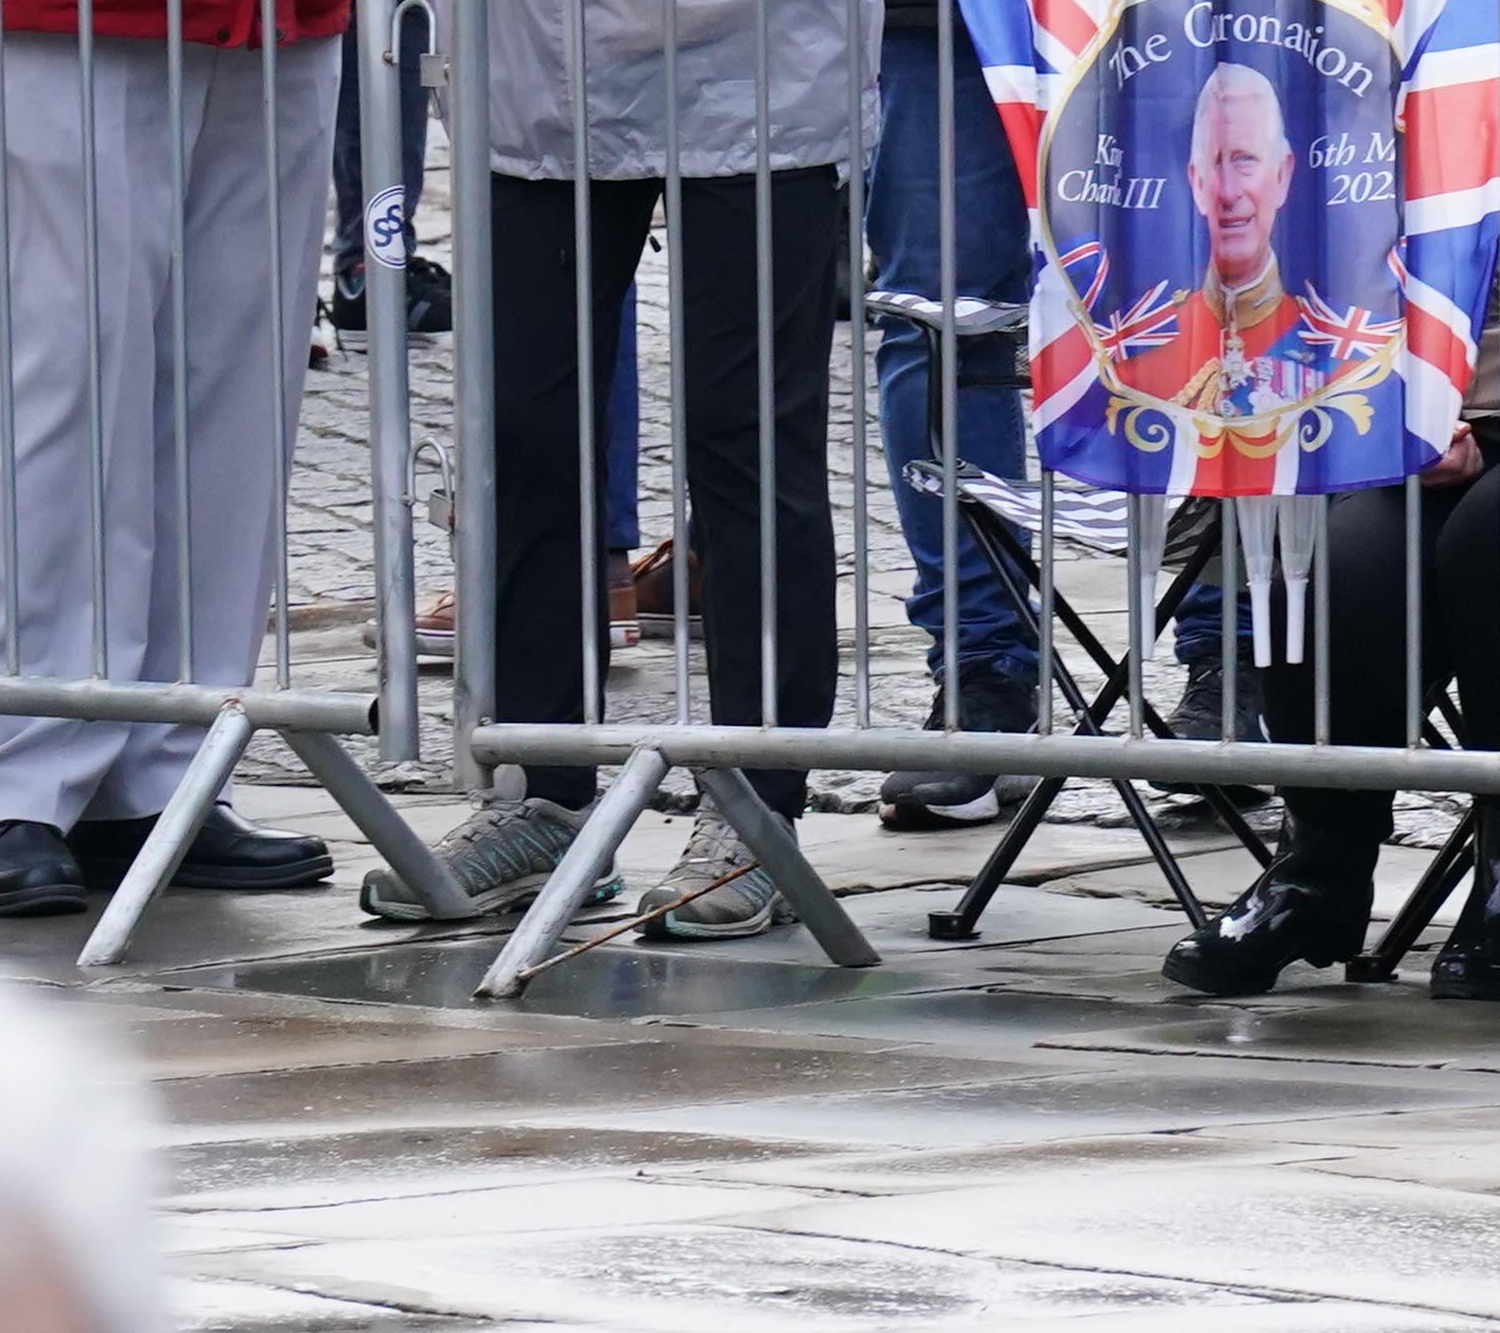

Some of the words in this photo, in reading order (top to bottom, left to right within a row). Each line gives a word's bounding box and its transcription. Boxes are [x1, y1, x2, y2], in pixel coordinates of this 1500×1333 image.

[1108, 32, 1173, 90] The
[1184, 1, 1375, 98] Cronation
[1309, 132, 1356, 179] 6th
[1122, 178, 1167, 209] III
[1326, 170, 1397, 206] 202
